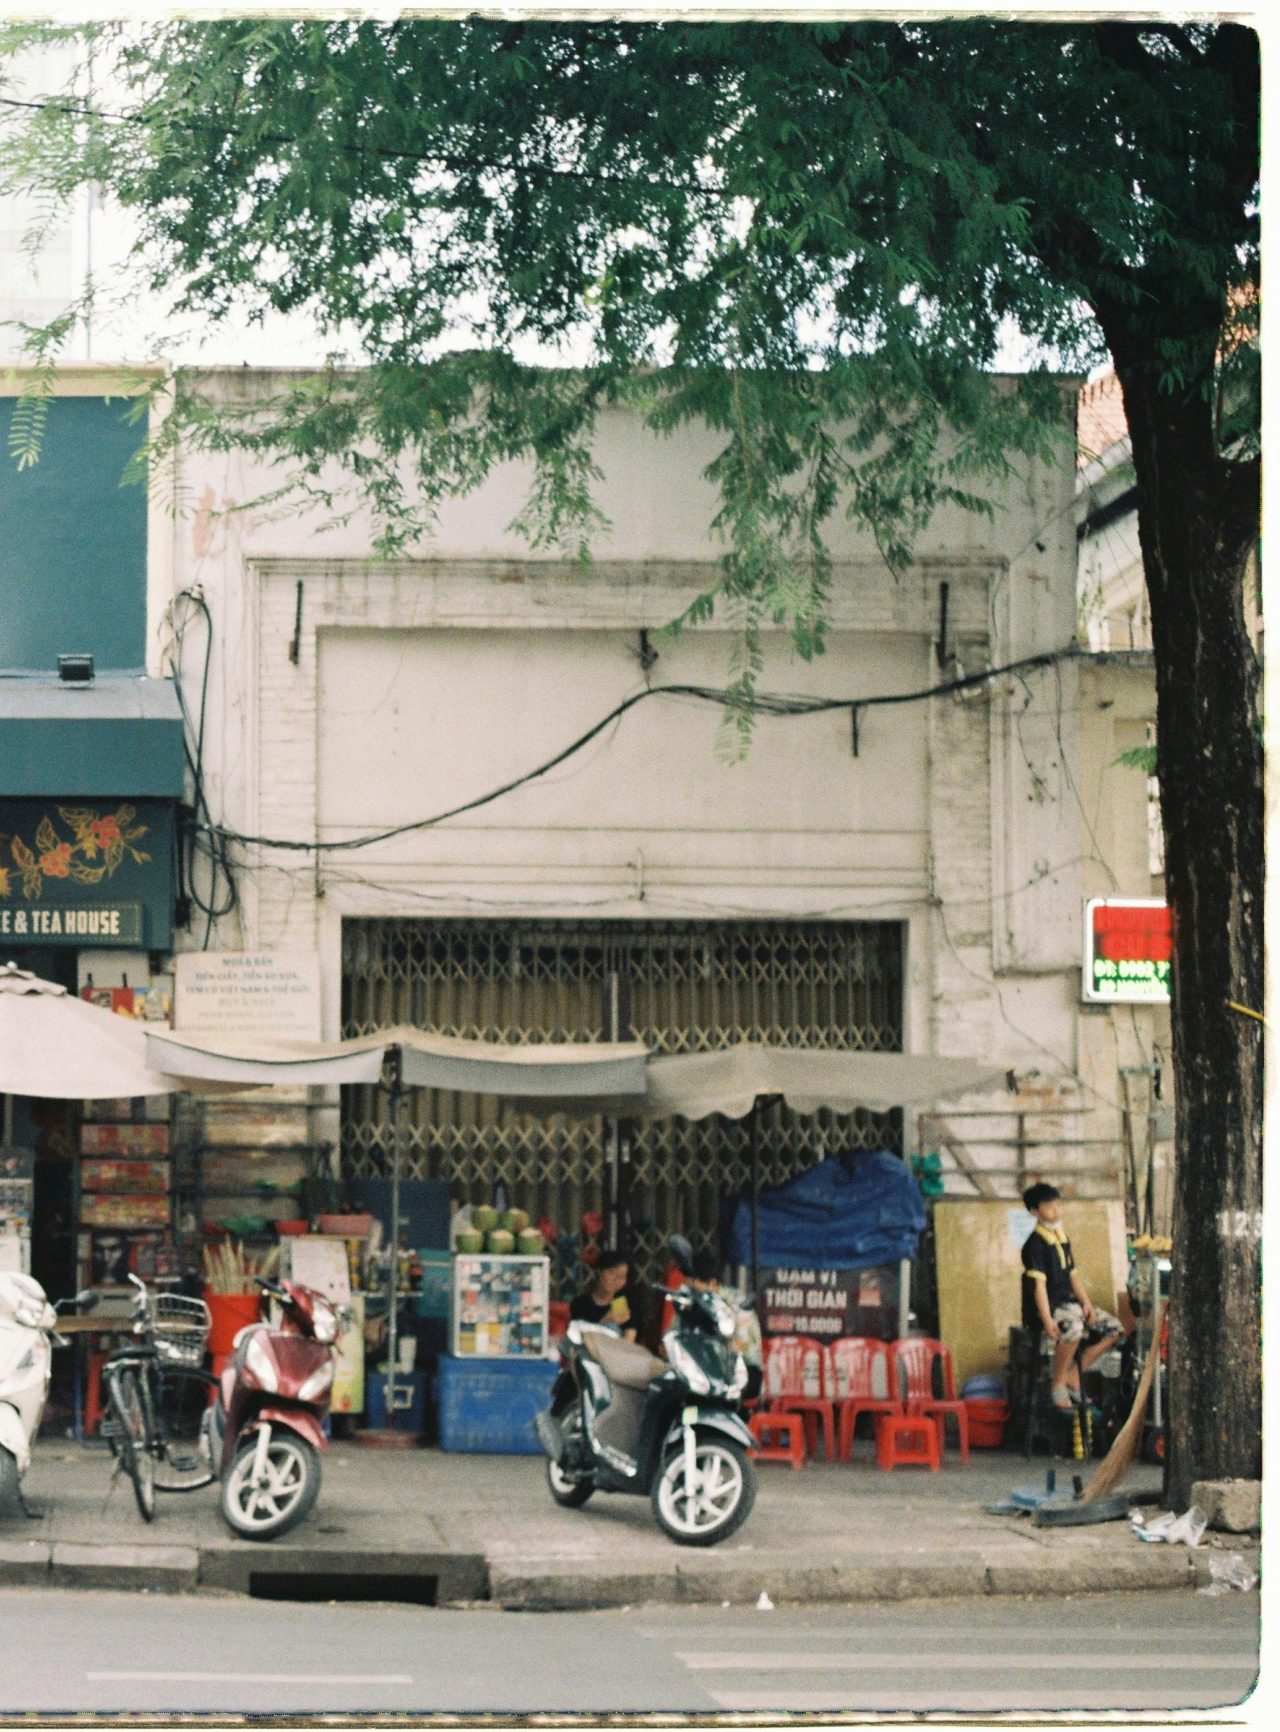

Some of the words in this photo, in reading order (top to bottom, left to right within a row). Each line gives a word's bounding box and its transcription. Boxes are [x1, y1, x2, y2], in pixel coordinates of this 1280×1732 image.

[14, 909, 28, 934] &
[32, 910, 62, 934] TEA
[65, 910, 120, 935] HOUSE
